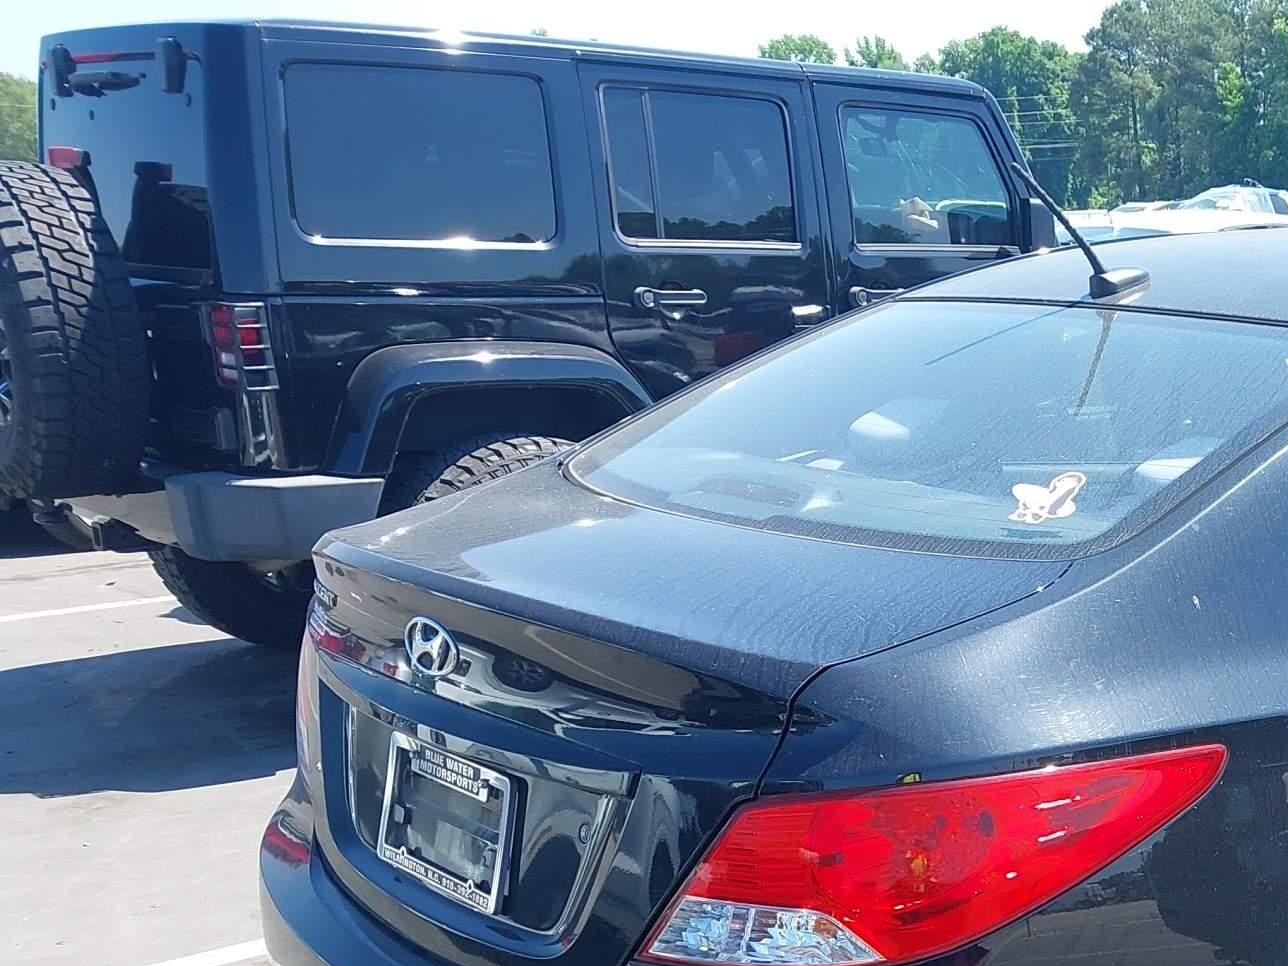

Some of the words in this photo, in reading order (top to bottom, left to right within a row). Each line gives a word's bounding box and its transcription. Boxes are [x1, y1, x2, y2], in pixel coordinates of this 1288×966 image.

[420, 759, 478, 793] MOTORSPORTS
[425, 749, 445, 767] BLUE
[446, 757, 474, 779] WATER
